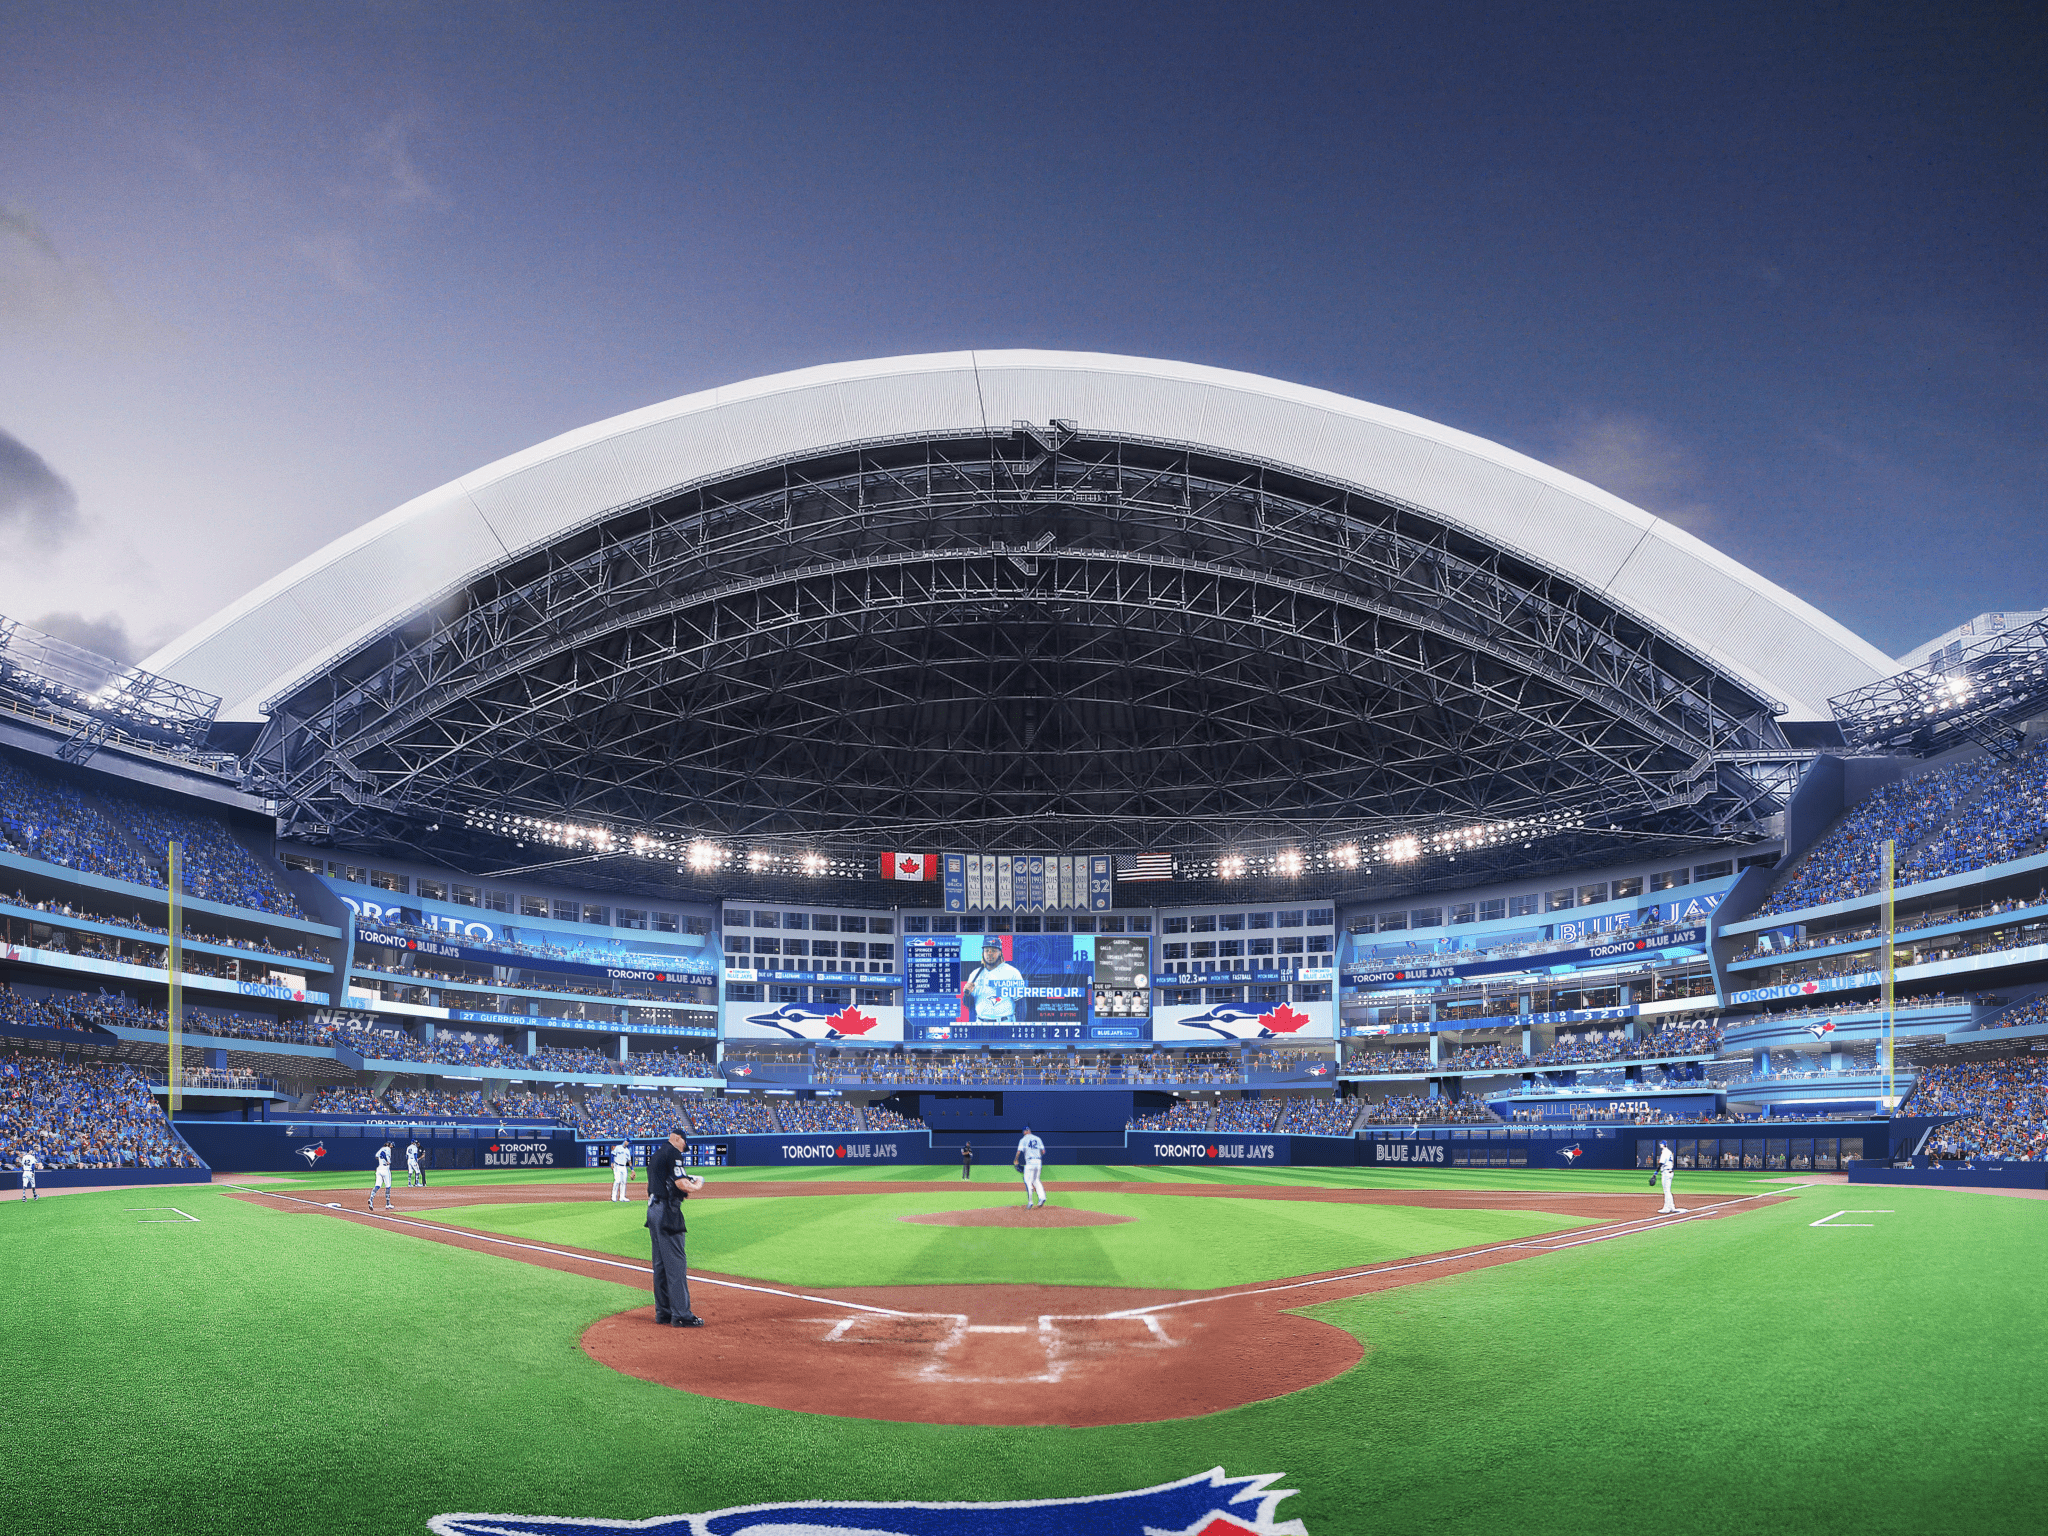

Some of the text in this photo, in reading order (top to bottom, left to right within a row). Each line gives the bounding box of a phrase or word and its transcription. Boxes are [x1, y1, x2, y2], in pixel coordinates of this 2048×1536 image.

[1091, 879, 1110, 893] 32
[359, 929, 460, 958] TORONTO BLUE JAYS
[1589, 930, 1696, 958] TORONTO BLUE JAYS
[1074, 950, 1088, 961] 1B
[607, 969, 713, 985] TORONTO BLUE JAYS
[1178, 974, 1198, 984] 102.3
[1353, 967, 1455, 983] TORONTO BLUE JAYS
[236, 981, 292, 1000] TORONTO
[1001, 987, 1082, 998] GUERRERO JR.
[1730, 983, 1800, 1005] TORONTO
[1819, 976, 1857, 992] BLUE
[480, 1014, 525, 1025] GUERRERO
[526, 1018, 540, 1026] JR.
[1584, 1009, 1624, 1020] 3 2 0
[1054, 1028, 1060, 1038] 2
[1074, 1028, 1080, 1038] 2
[500, 1143, 547, 1152] TORONTO
[1028, 1139, 1038, 1149] 42
[484, 1152, 554, 1165] BLUE JAYS
[782, 1144, 898, 1159] TORONTO BLUE JAYS
[1154, 1144, 1275, 1159] TORONTO BLUE JAYS
[1376, 1144, 1445, 1163] BLUE JAYS
